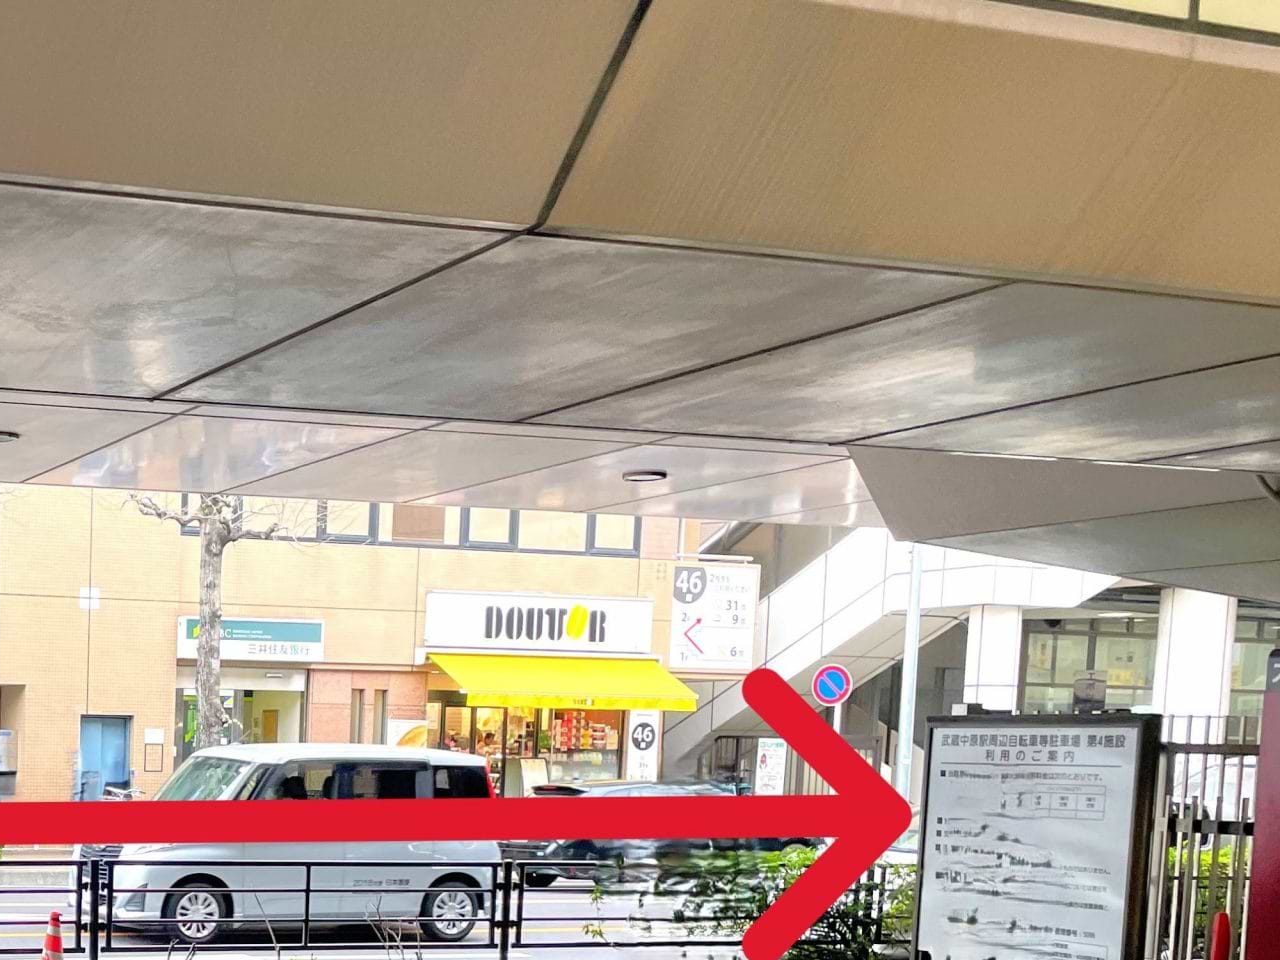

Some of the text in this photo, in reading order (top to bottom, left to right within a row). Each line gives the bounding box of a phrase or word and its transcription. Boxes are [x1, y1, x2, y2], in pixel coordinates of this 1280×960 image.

[675, 570, 703, 594] 46
[485, 603, 607, 643] DOUTOR
[633, 726, 653, 742] 46
[985, 749, 1075, 762] 利用のご案内
